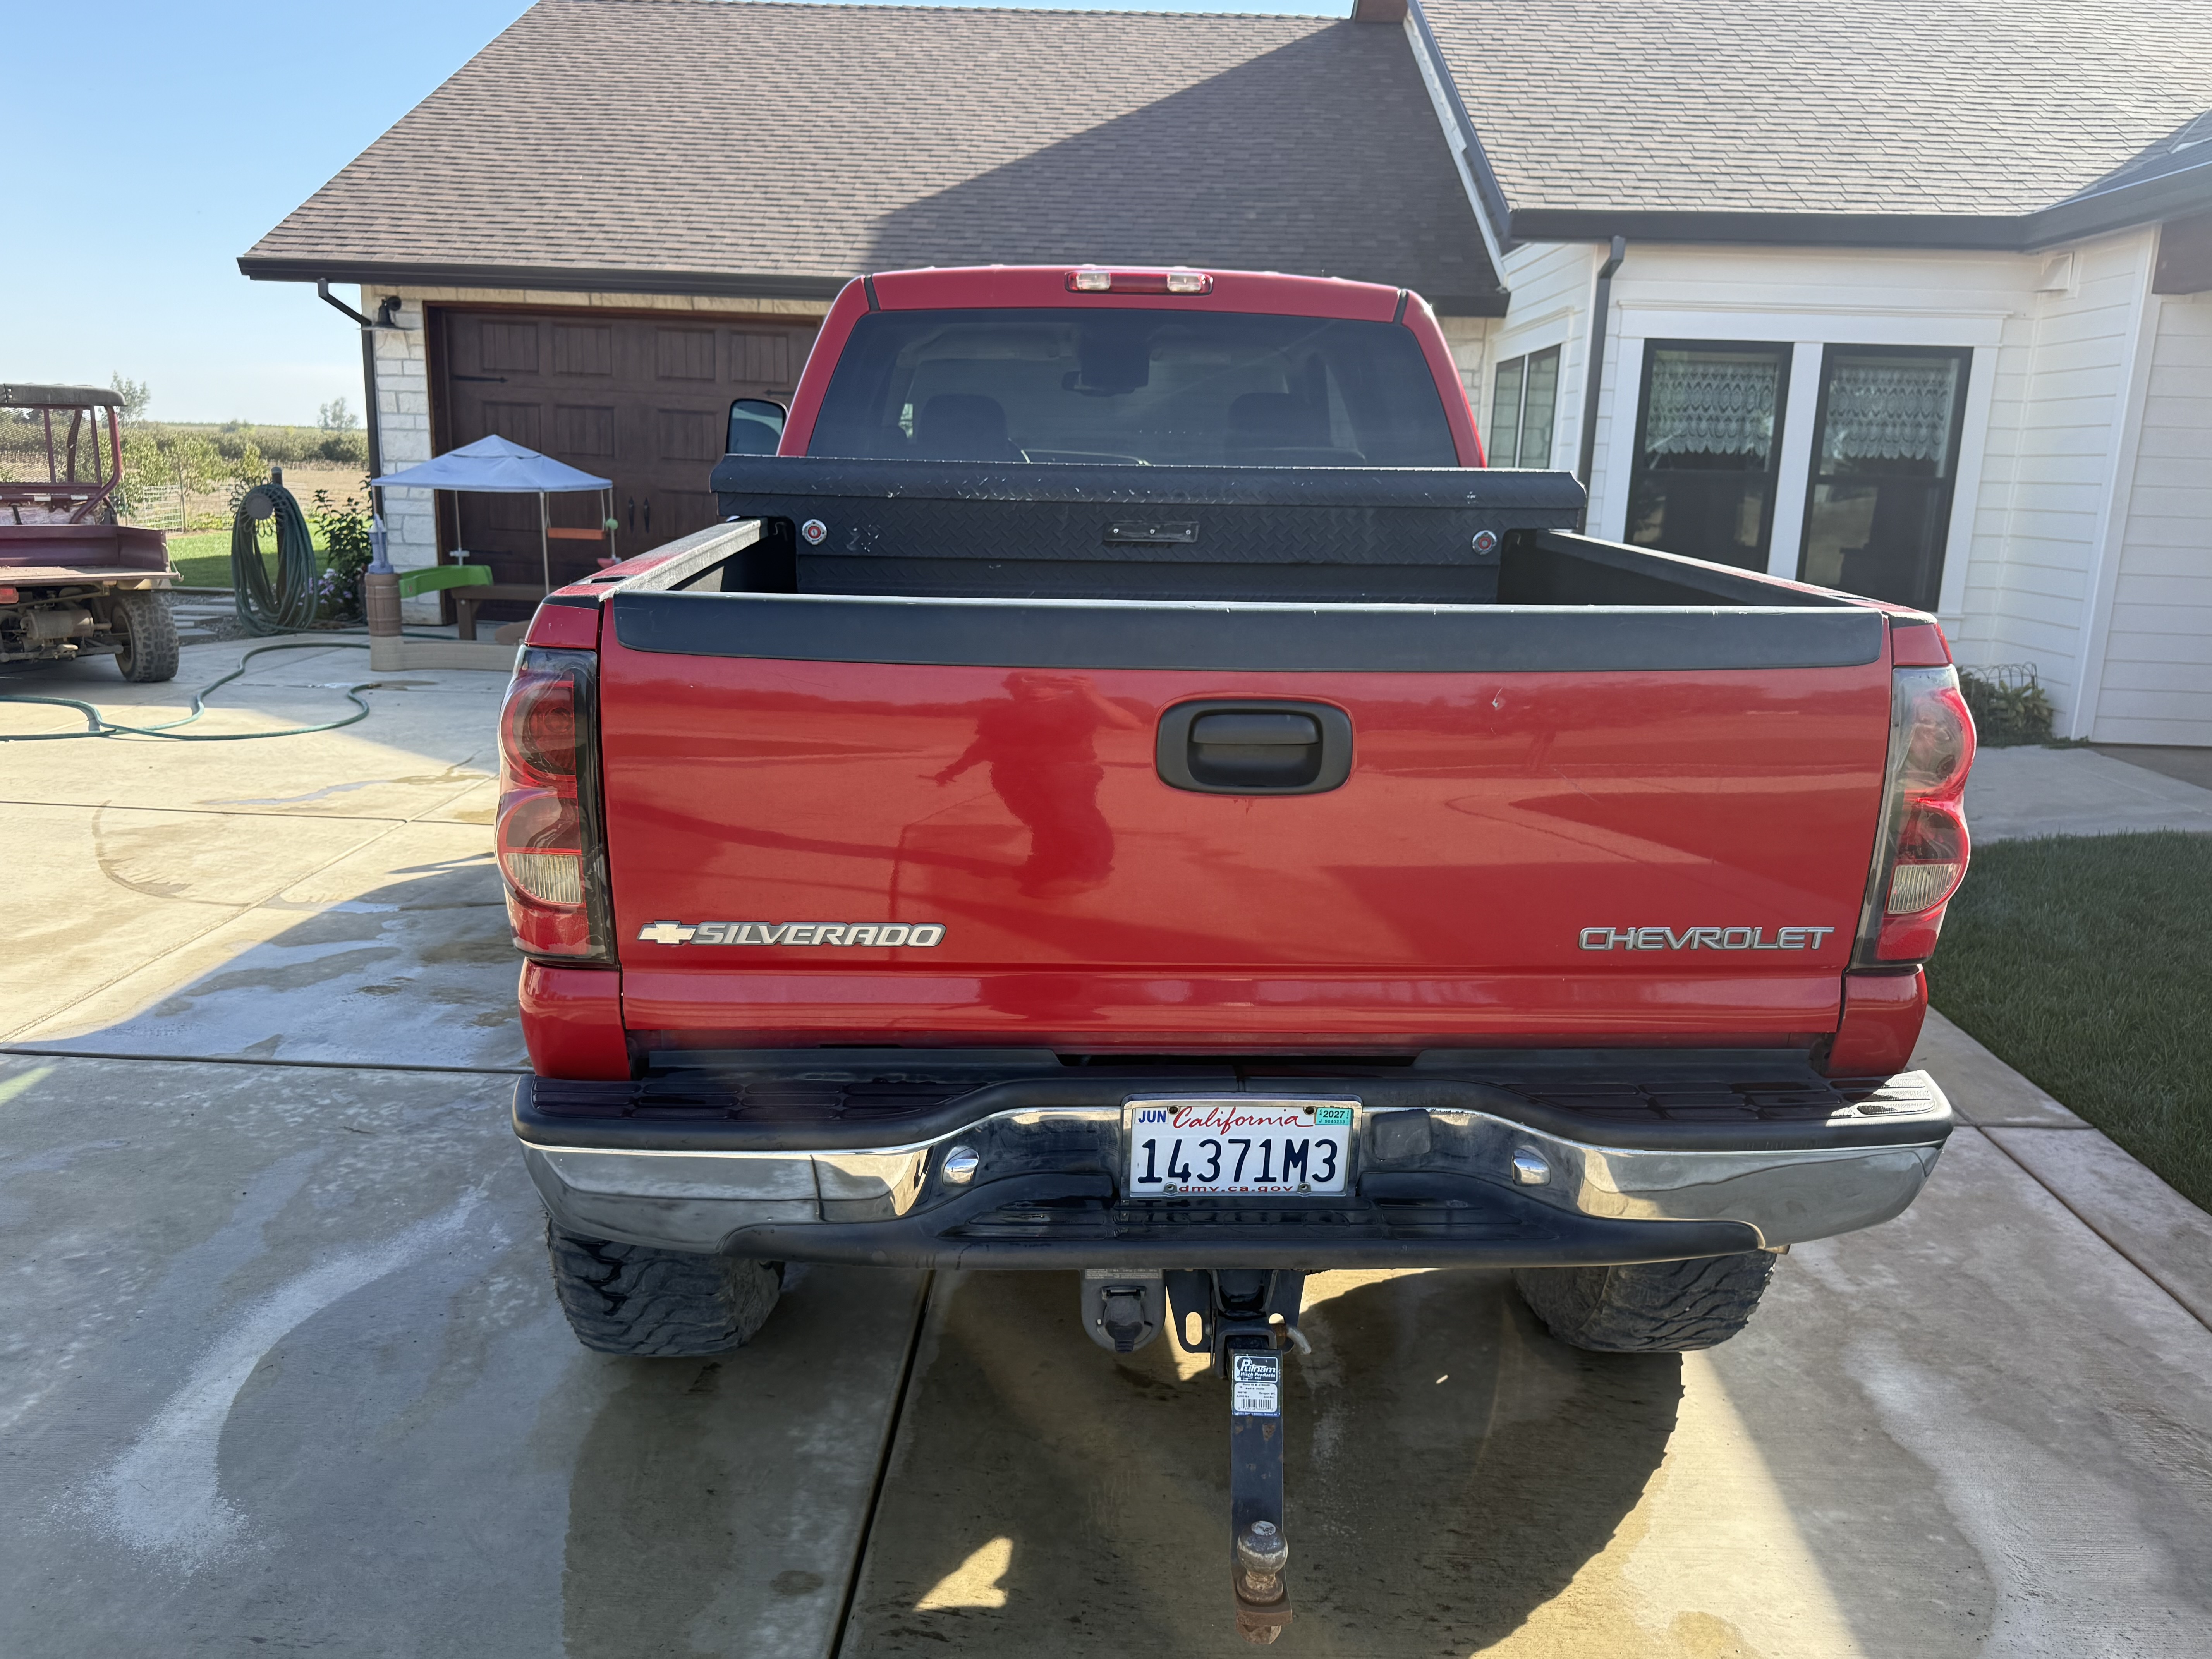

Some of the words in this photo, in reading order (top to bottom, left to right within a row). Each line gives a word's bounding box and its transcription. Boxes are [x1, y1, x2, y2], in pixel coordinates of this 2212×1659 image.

[694, 924, 942, 946] SILVERADO
[1579, 927, 1834, 950] CHEVROLET
[1138, 1110, 1166, 1123] JUN
[1173, 1106, 1314, 1135] California
[1323, 1110, 1345, 1118] 2027
[1138, 1139, 1338, 1183] 14371M3
[1240, 1359, 1276, 1373] Putnam
